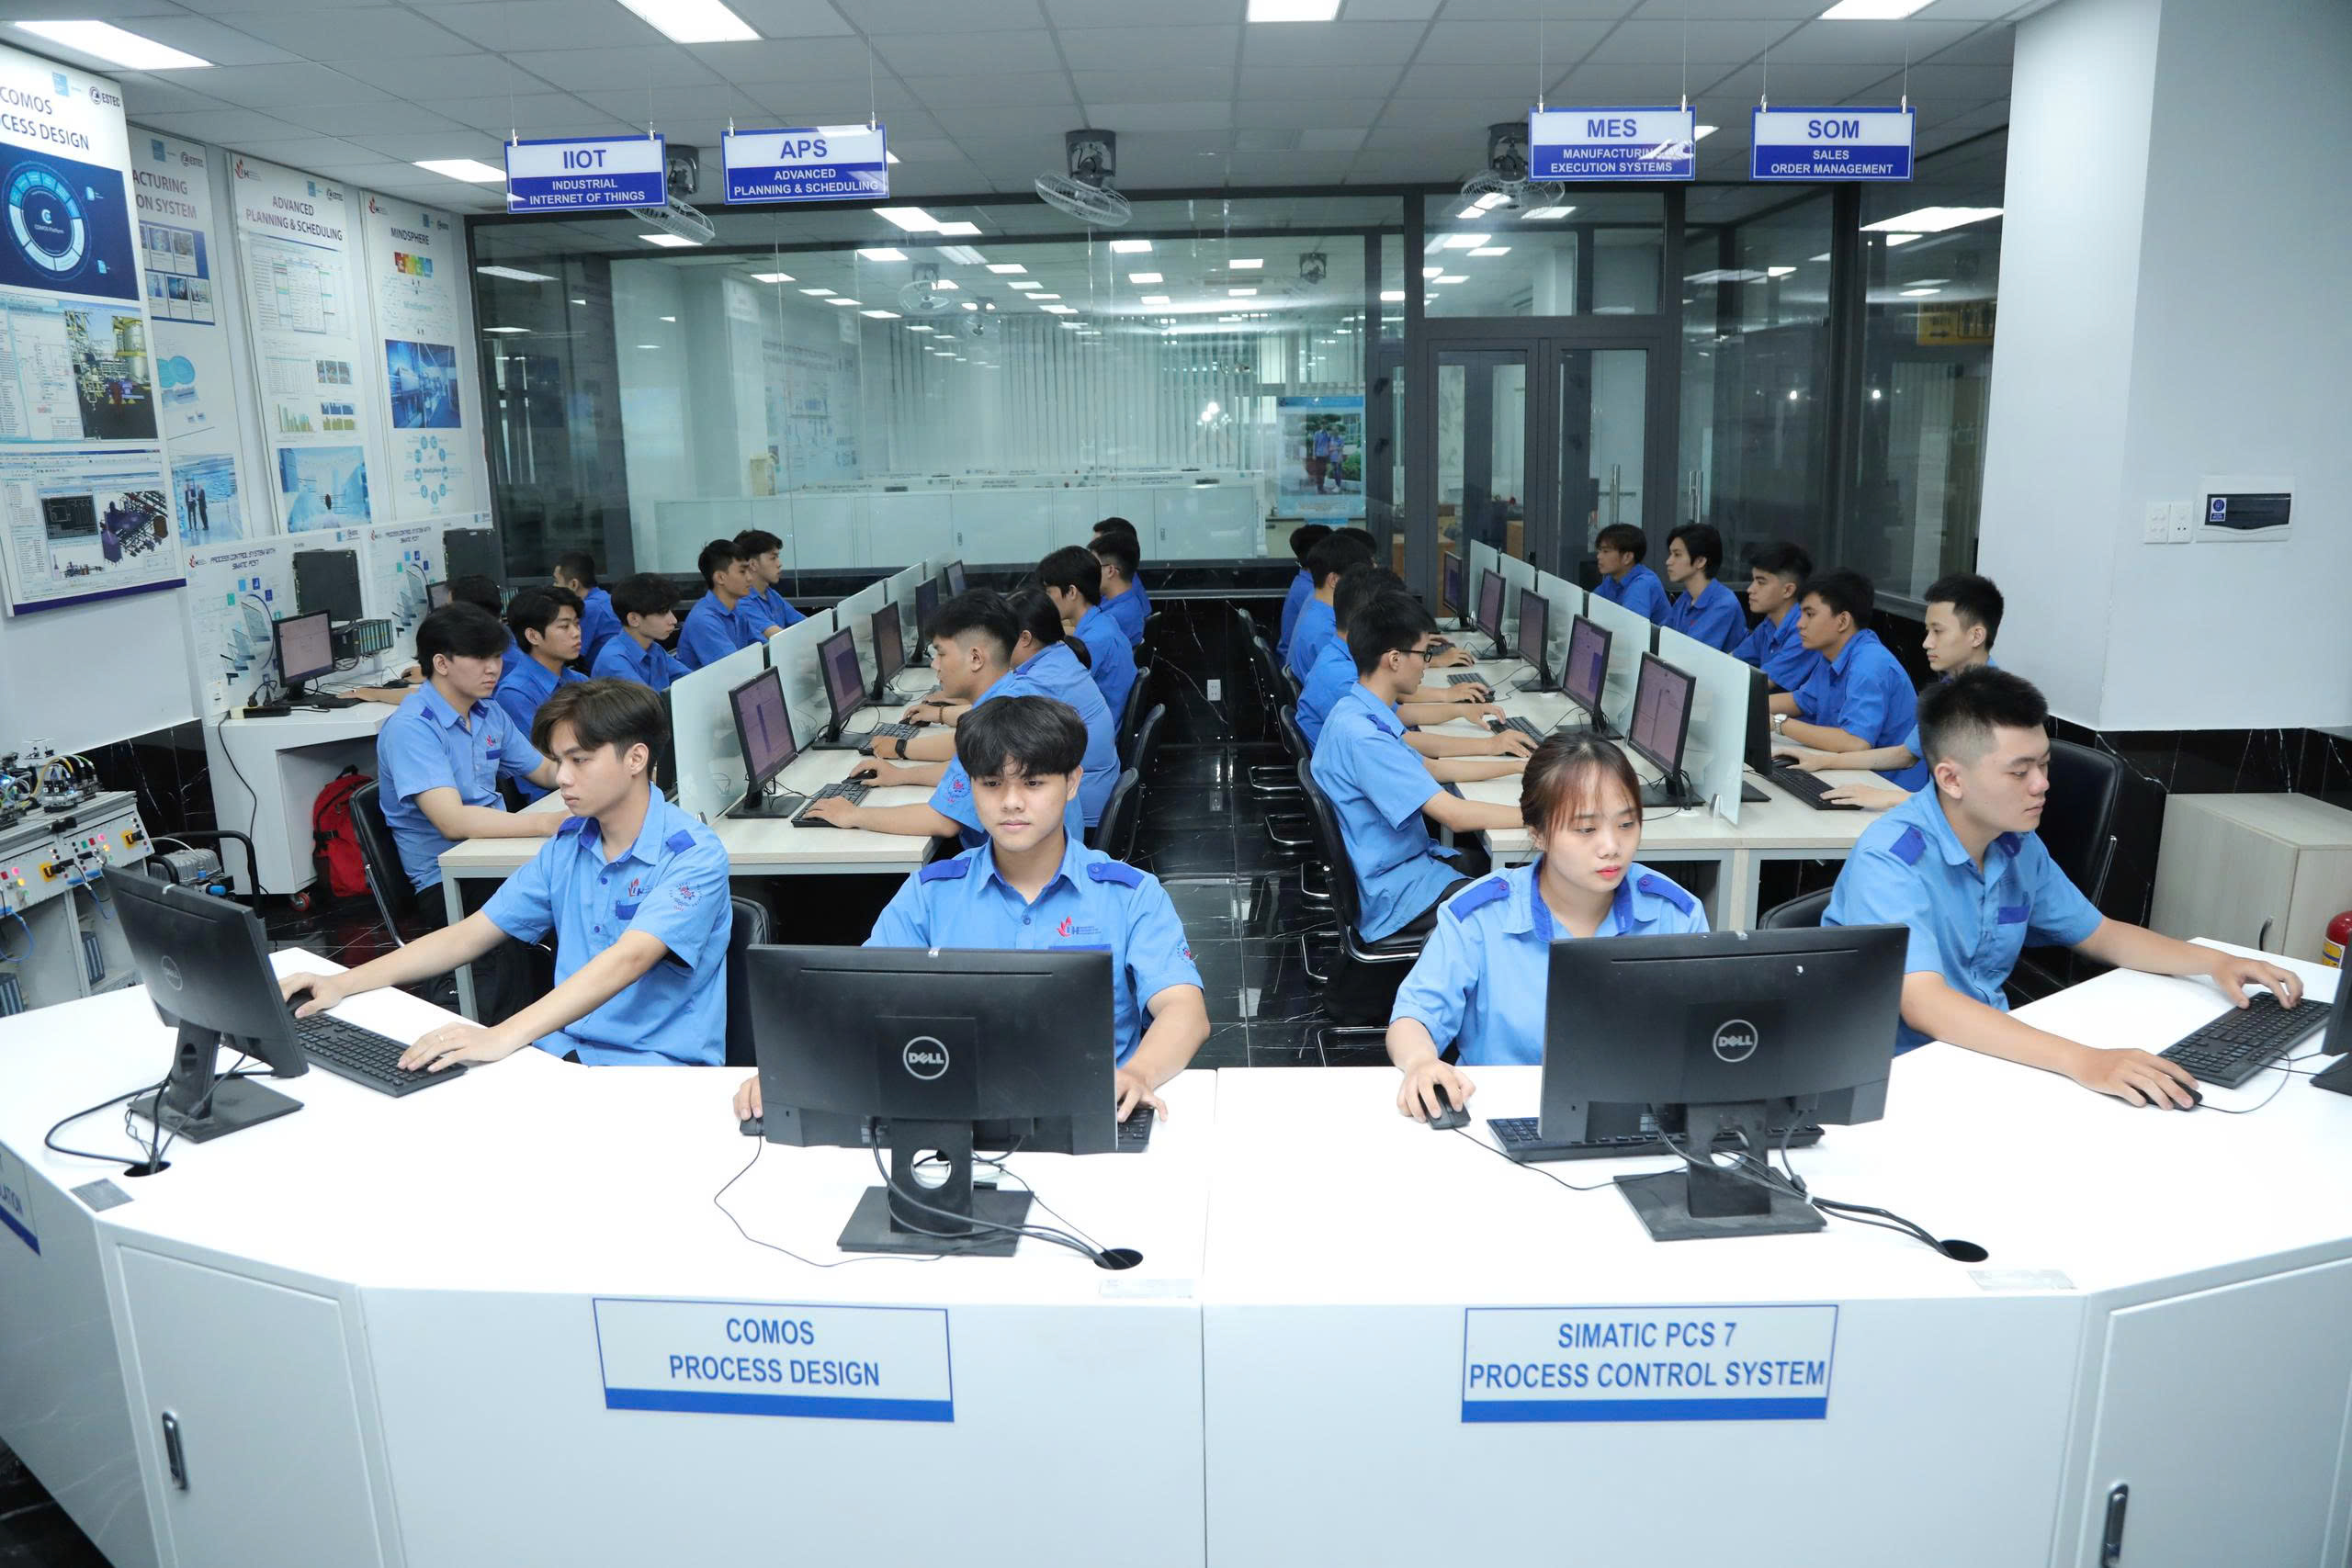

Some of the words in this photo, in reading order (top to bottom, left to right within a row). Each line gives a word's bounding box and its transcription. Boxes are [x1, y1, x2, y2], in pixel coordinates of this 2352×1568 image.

[0, 86, 52, 115] COMOS
[101, 93, 120, 107] ESTEC
[40, 123, 89, 151] DESIGN
[1588, 118, 1637, 138] MES
[1808, 119, 1860, 139] SOM
[563, 149, 606, 169] IIOT
[780, 139, 828, 159] APS
[1813, 150, 1849, 160] SALES
[774, 168, 836, 181] ADVANCED
[1551, 163, 1616, 173] EXECUTION
[1619, 162, 1673, 172] SYSTEMS
[1770, 164, 1811, 174] ORDER
[1814, 164, 1894, 175] MANAGEMENT
[552, 178, 618, 191] INDUSTRIAL
[734, 184, 791, 196] PLANNING
[794, 183, 803, 194] &
[805, 181, 878, 194] SCHEDULING
[272, 196, 315, 217] ADVANCED
[529, 193, 583, 205] INTERNET
[586, 193, 602, 203] OF
[605, 190, 646, 202] THINGS
[154, 197, 198, 220] SYSTEM
[245, 208, 289, 230] PLANNING
[289, 219, 296, 231] &
[297, 220, 344, 242] SCHEDULING
[390, 226, 430, 246] MINDSPHERE
[1718, 1034, 1753, 1047] DELL
[909, 1052, 944, 1065] DELL
[726, 1318, 815, 1346] COMOS
[1558, 1323, 1657, 1348] SIMATIC
[1666, 1322, 1715, 1348] PCS
[1725, 1322, 1737, 1347] 7
[670, 1355, 783, 1383] PROCESS
[790, 1359, 880, 1387] DESIGN
[1470, 1363, 1589, 1389] PROCESS
[1597, 1361, 1717, 1388] CONTROL
[1724, 1360, 1826, 1386] SYSTEM
